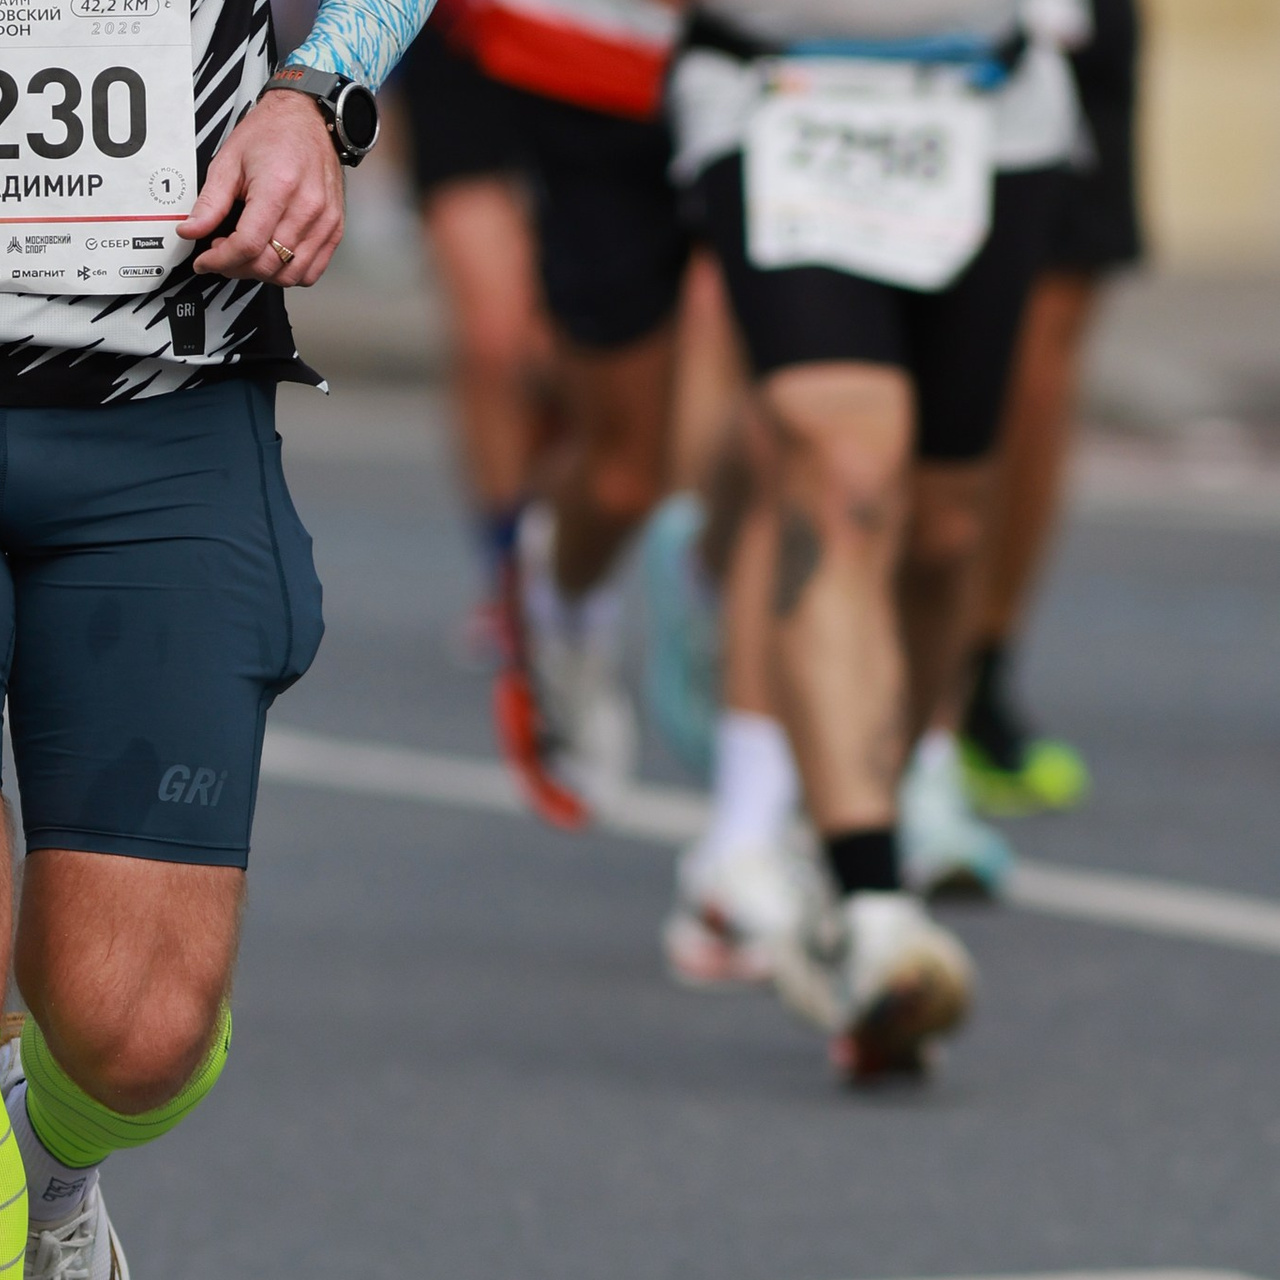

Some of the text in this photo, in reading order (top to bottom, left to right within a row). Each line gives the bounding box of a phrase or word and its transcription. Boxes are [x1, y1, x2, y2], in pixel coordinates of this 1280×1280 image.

[91, 21, 142, 36] 2026
[161, 178, 170, 193] 1
[25, 234, 72, 245] МОСКОВСКИЙ
[100, 239, 130, 249] СБЕР
[25, 245, 48, 254] СПОРТ
[122, 268, 155, 276] WINLINE
